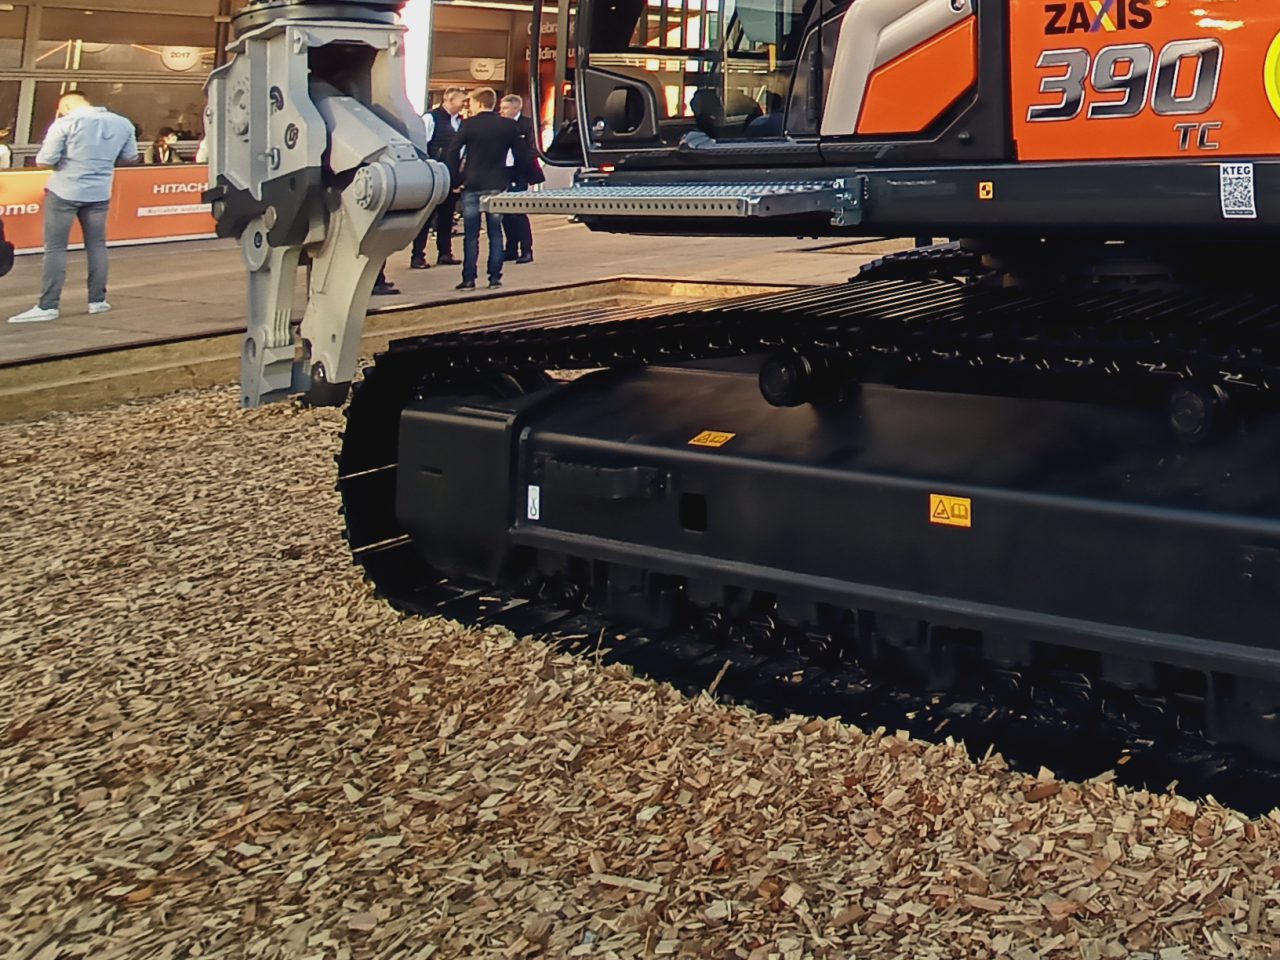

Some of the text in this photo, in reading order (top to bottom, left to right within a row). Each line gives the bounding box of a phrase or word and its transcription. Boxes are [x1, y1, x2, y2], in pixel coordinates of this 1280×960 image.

[170, 51, 190, 59] 2017
[1026, 37, 1224, 122] 390
[1173, 121, 1222, 151] TC
[1222, 166, 1251, 175] KTEG
[153, 183, 209, 194] HITACH
